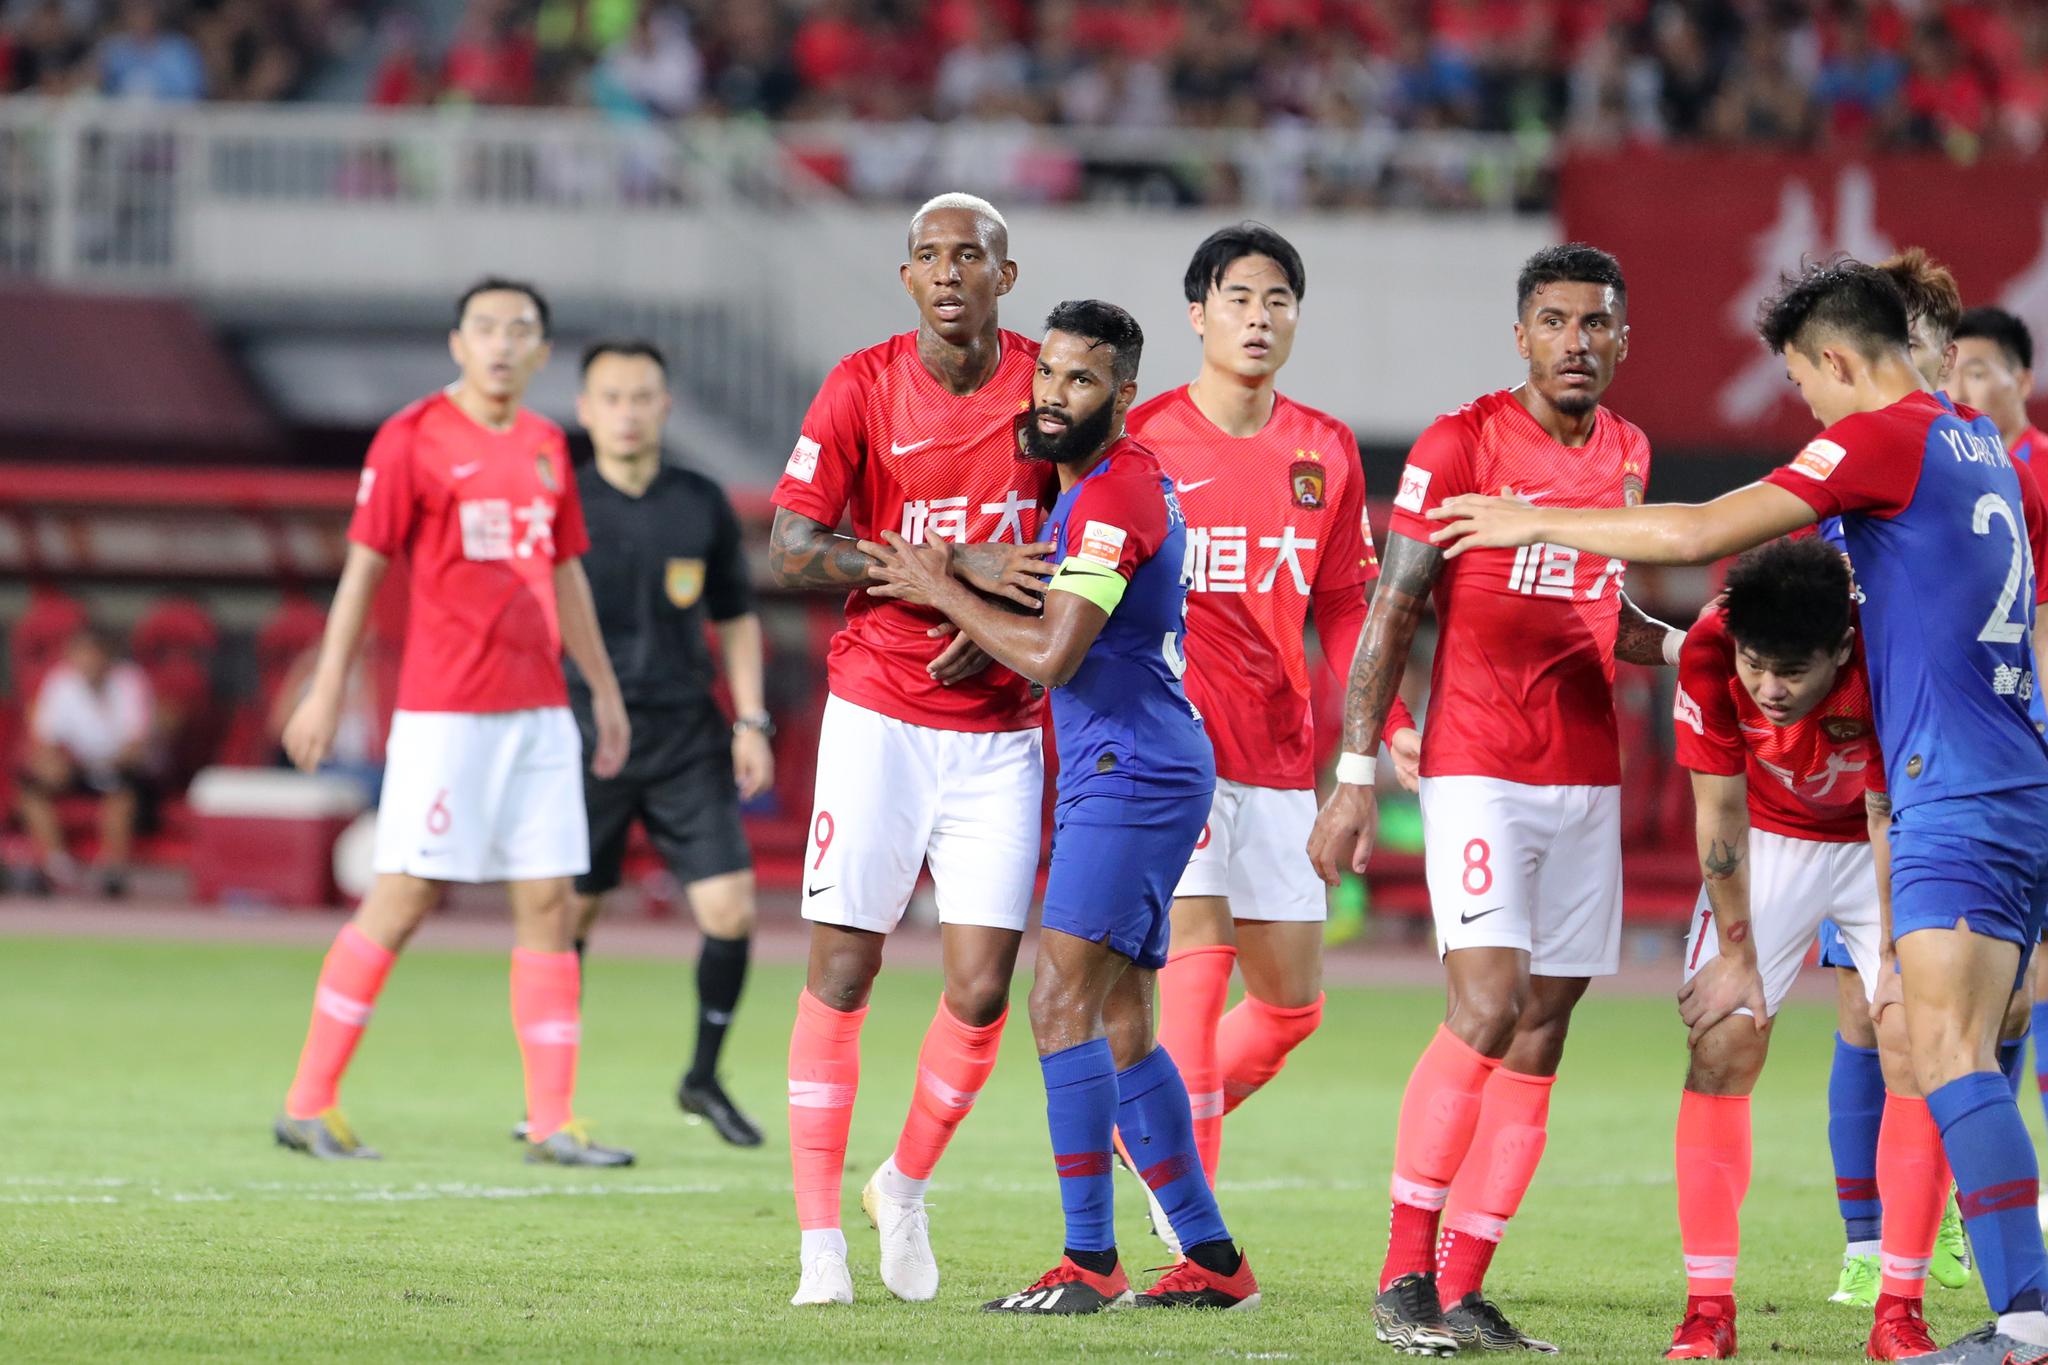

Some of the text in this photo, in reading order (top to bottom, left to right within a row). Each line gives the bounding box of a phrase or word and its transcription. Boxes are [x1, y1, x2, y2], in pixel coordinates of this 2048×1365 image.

[1181, 526, 1317, 596] 恒大
[426, 788, 452, 835] 6
[813, 810, 835, 870] 9
[1462, 837, 1494, 896] 8
